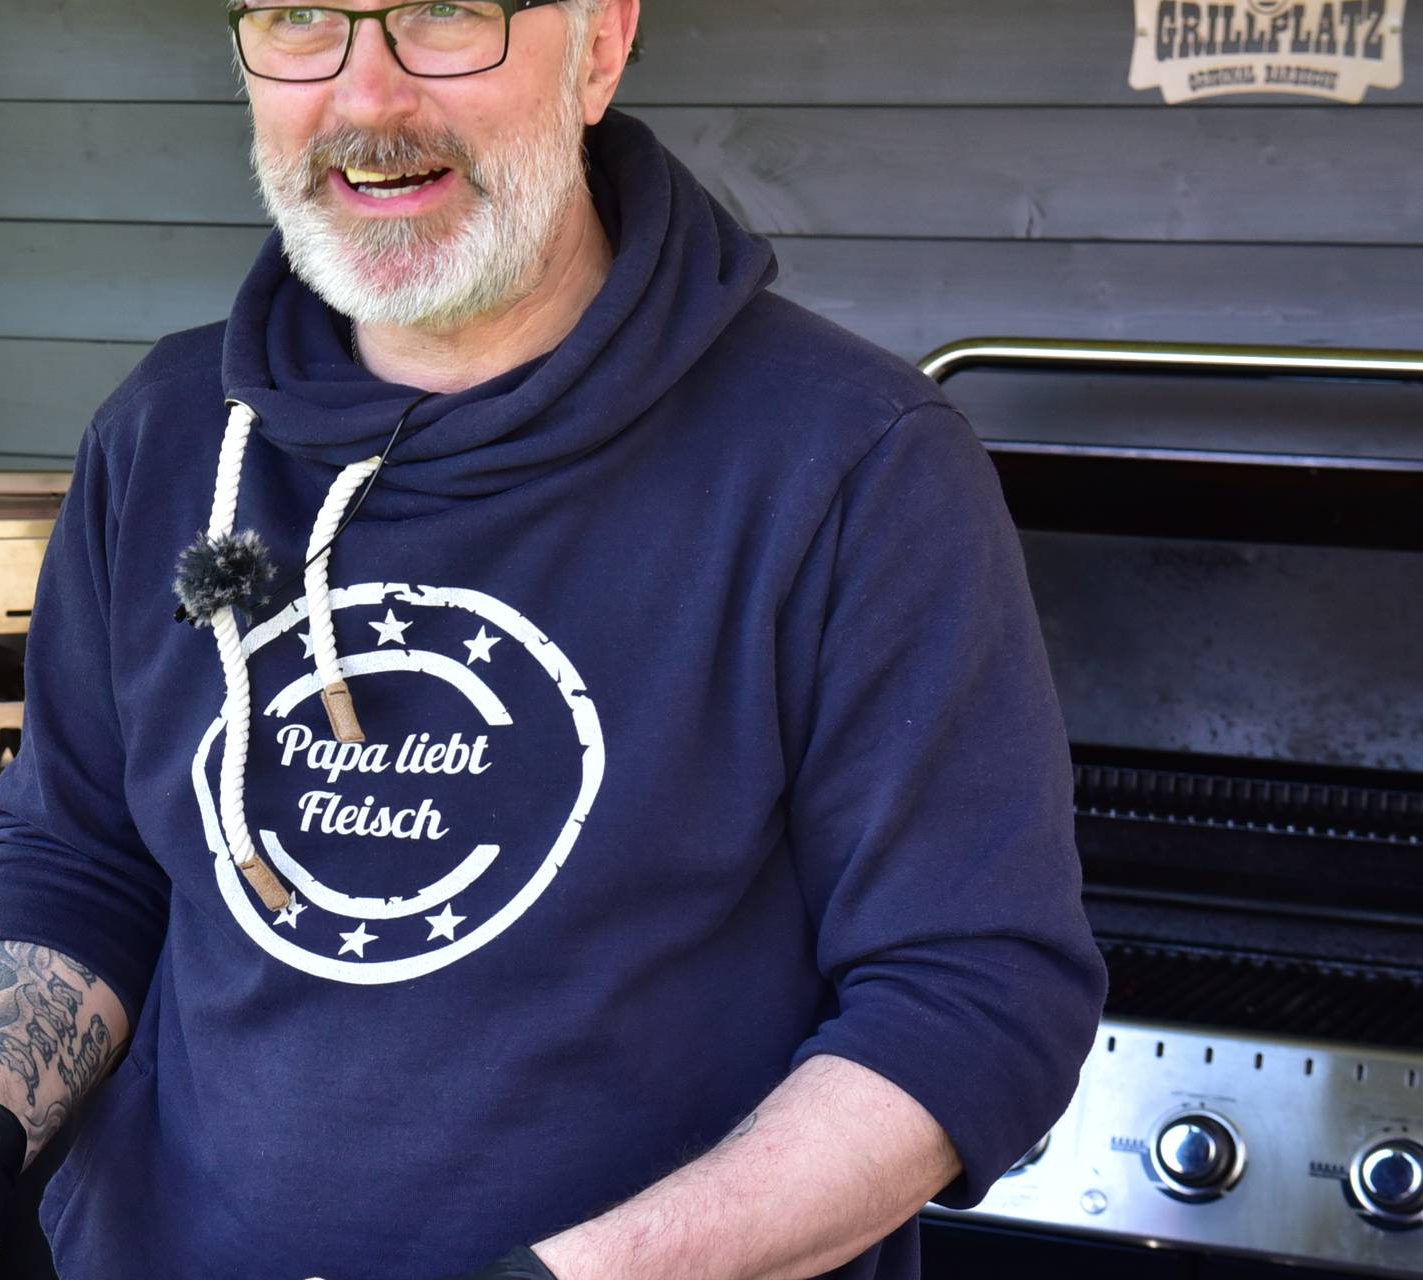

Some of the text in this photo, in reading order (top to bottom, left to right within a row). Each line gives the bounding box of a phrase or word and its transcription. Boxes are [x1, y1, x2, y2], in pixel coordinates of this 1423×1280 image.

[1155, 0, 1385, 62] GRILLPLATZ
[276, 724, 493, 783] Papa liebt
[298, 790, 450, 840] Fleisch
